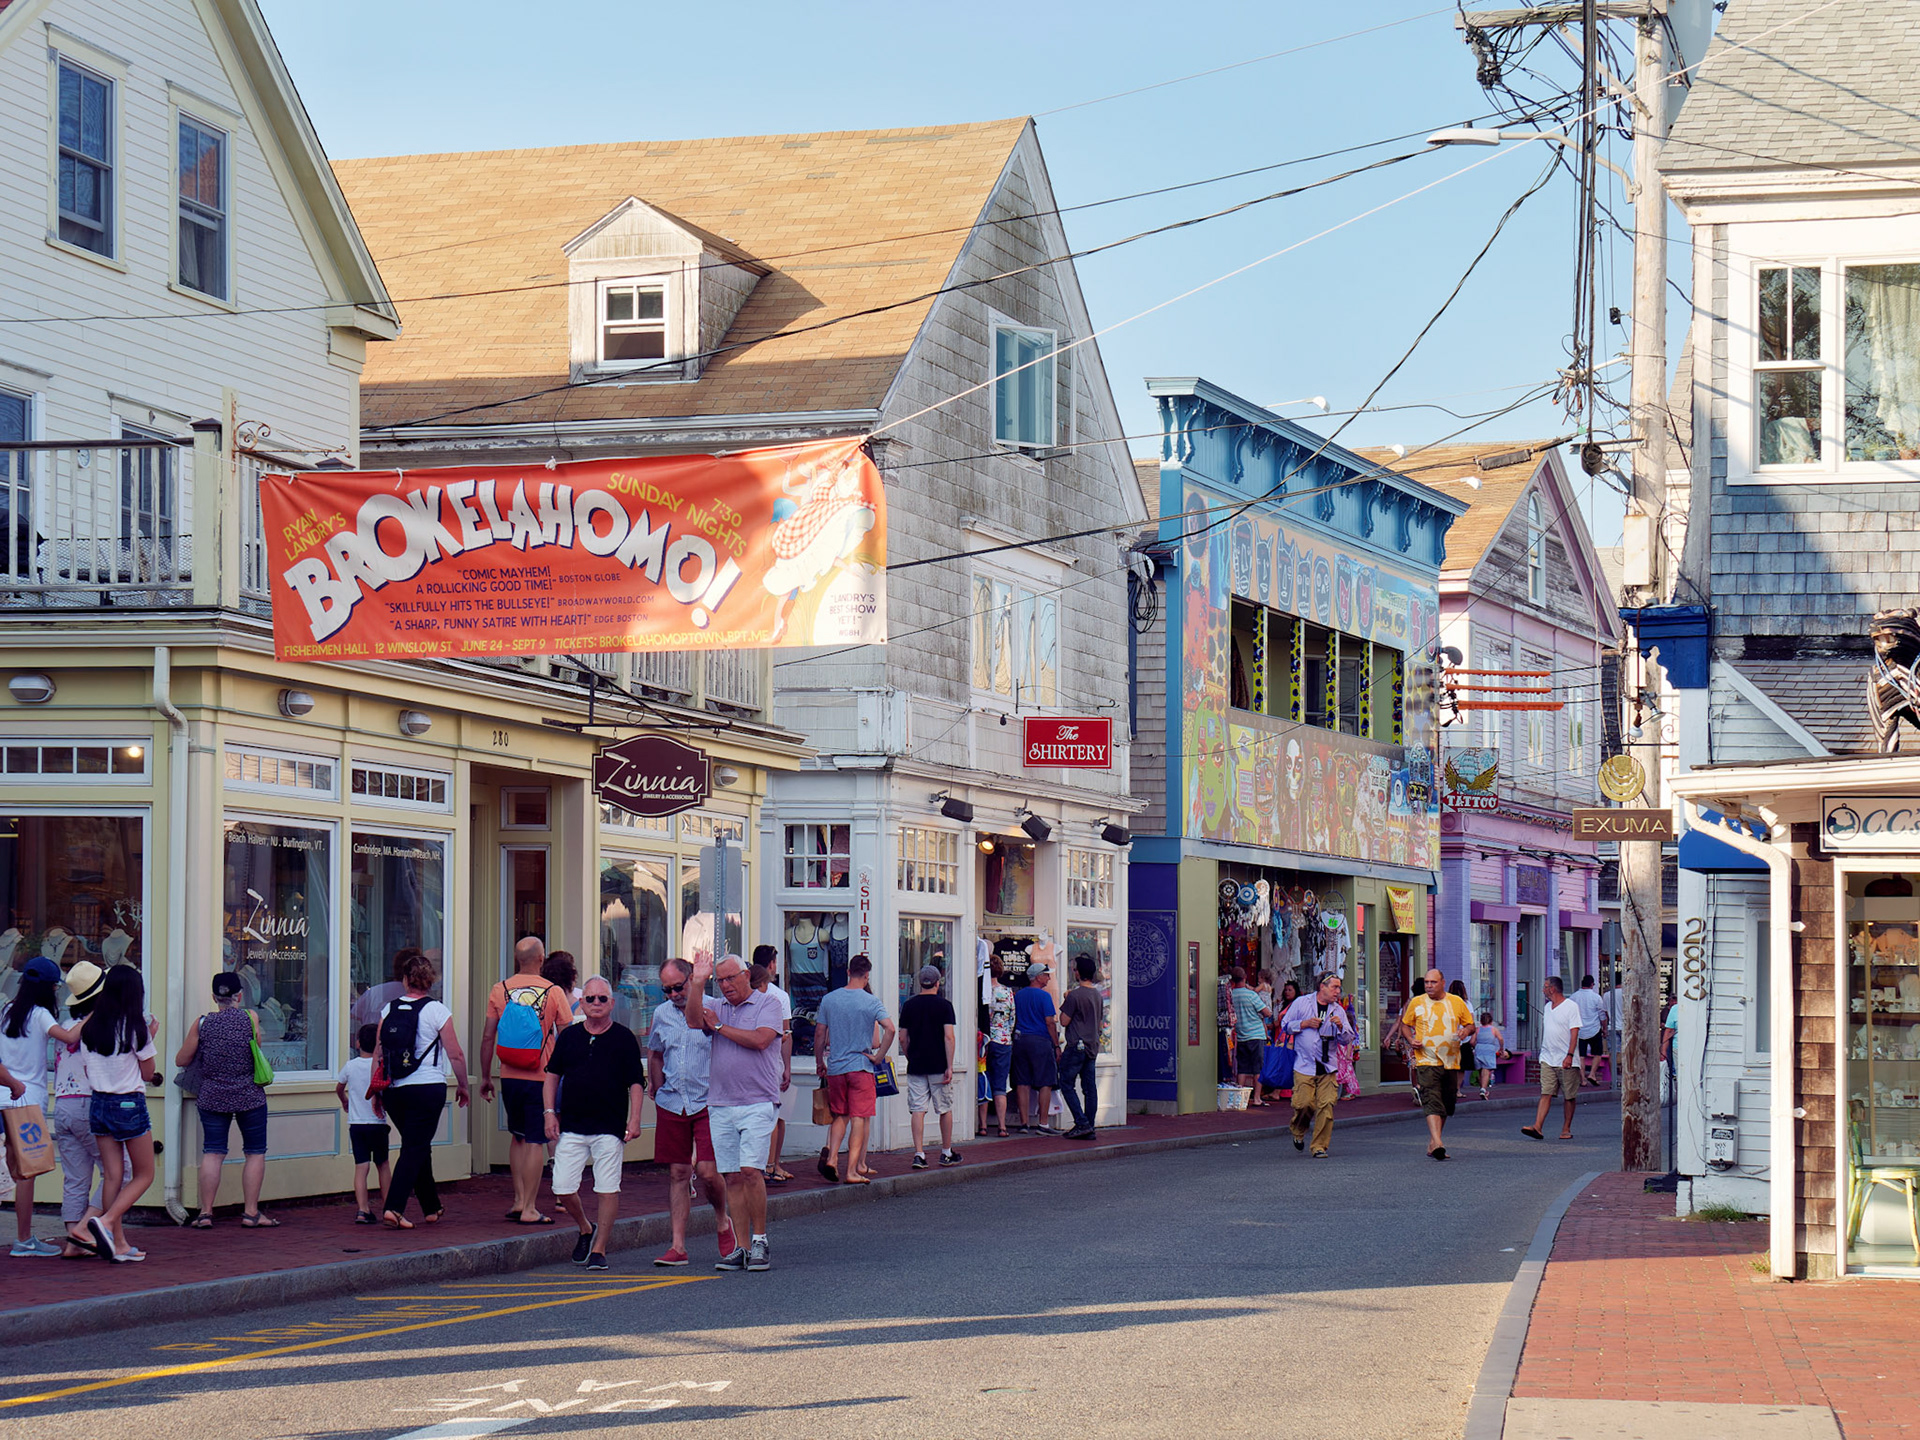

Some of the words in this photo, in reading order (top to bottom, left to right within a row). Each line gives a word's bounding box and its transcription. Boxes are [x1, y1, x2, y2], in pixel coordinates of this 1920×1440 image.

[607, 472, 684, 513] SUNDAY
[686, 503, 747, 558] NIGHTS
[711, 497, 742, 528] 7:30
[282, 507, 318, 543] RYAN
[284, 511, 347, 562] LANDRY'S
[283, 478, 743, 644] BROKELAHOMO!
[457, 568, 497, 581] "COMIC
[500, 565, 552, 579] MAYHEM!
[559, 573, 592, 583] BOSTON
[595, 573, 621, 582] GLOBE
[416, 584, 424, 595] A
[427, 581, 487, 594] ROLLICKING
[490, 580, 522, 592] GOOD
[524, 578, 556, 591] TIME!"
[385, 600, 447, 614] "SKILLFULLY
[450, 600, 472, 612] HITS
[475, 599, 494, 611] THE
[497, 596, 555, 610] BULLSEYE!"
[558, 596, 655, 607] BROADWAYWORLD.COM
[845, 604, 877, 614] SHOW
[443, 618, 480, 630] FUNNY
[482, 617, 517, 629] SATIRE
[520, 615, 547, 627] WITH
[550, 614, 591, 626] HEART!"
[594, 615, 614, 624] EDGE
[617, 614, 648, 623] BOSTON
[284, 644, 342, 657] FISHERMEN
[343, 643, 369, 655] HALL
[374, 643, 384, 654] 12
[387, 641, 438, 654] WINSLOW
[440, 641, 452, 653] ST
[461, 640, 488, 652] JUNE
[490, 639, 503, 651] 24
[512, 638, 537, 650] SEPT
[538, 638, 546, 650] 9
[554, 637, 598, 650] TICKETS:
[492, 730, 509, 747] 280
[1056, 725, 1079, 740] The
[1029, 742, 1106, 760] SHIRTERY
[599, 752, 703, 797] Zinnia
[1446, 795, 1498, 809] TATTOO
[1581, 817, 1667, 833] EXUMA
[228, 832, 247, 843] Beach
[243, 888, 311, 944] Zinnia
[246, 948, 269, 962] Jewelry
[274, 949, 307, 960] Accessories
[1682, 916, 1708, 1001] 283
[150, 1303, 482, 1352] PARKING
[459, 1378, 733, 1393] WAY
[393, 1398, 682, 1414] ONE
